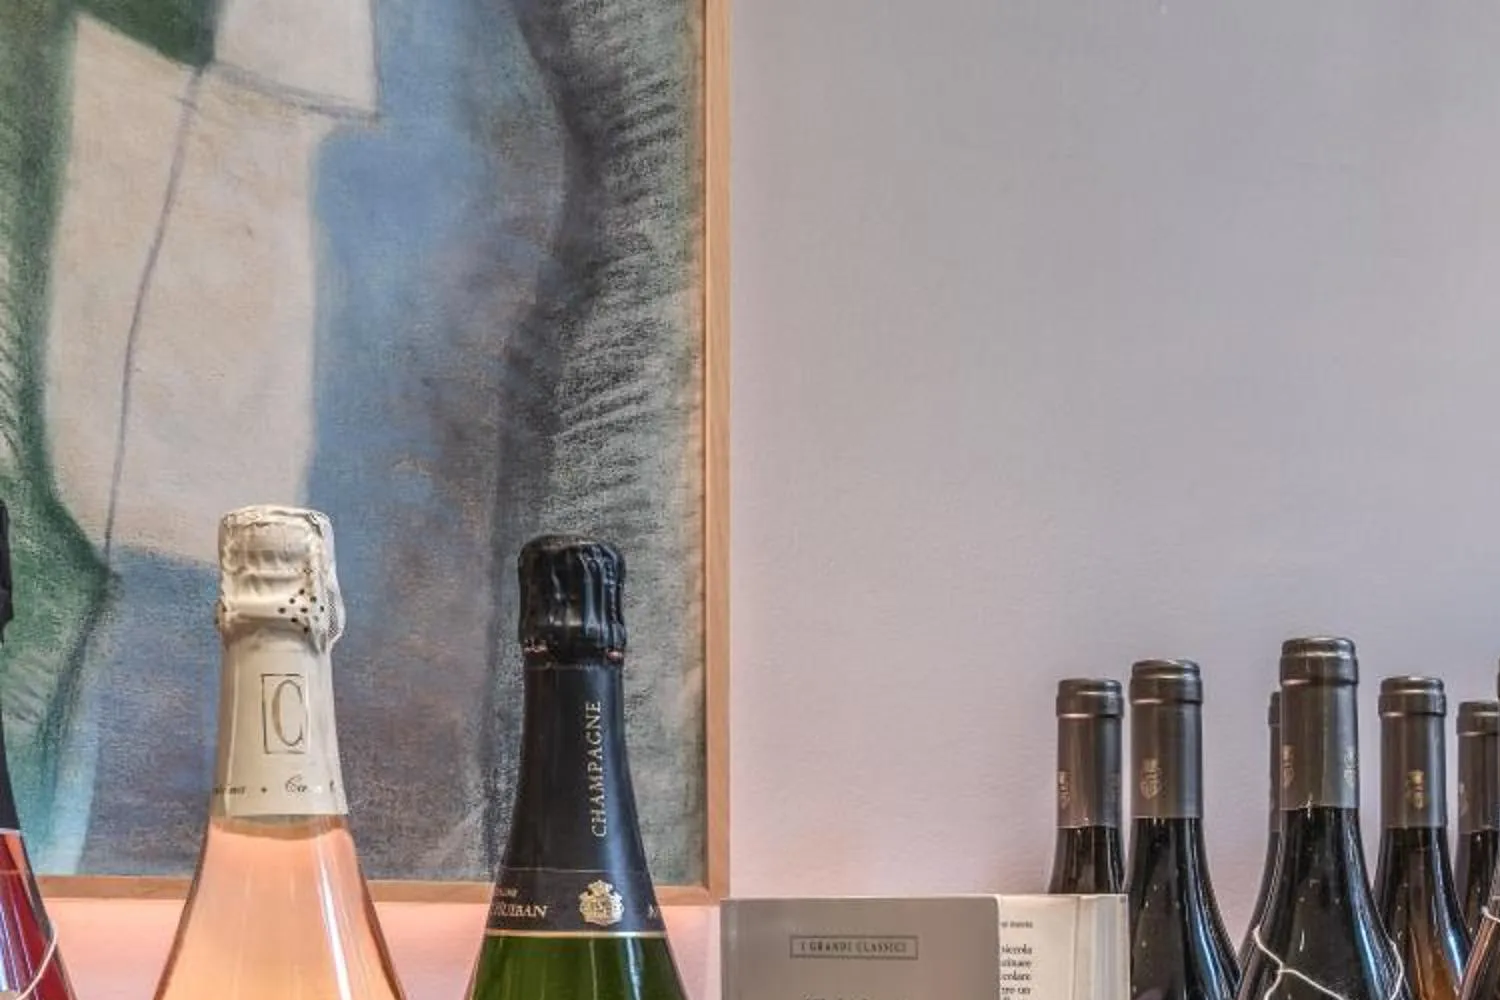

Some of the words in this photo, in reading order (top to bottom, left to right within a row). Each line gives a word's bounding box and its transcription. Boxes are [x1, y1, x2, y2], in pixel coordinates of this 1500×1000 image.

[585, 701, 607, 837] CHAMPAGNE
[809, 941, 852, 953] GRANDI
[855, 942, 907, 953] CLASSICI
